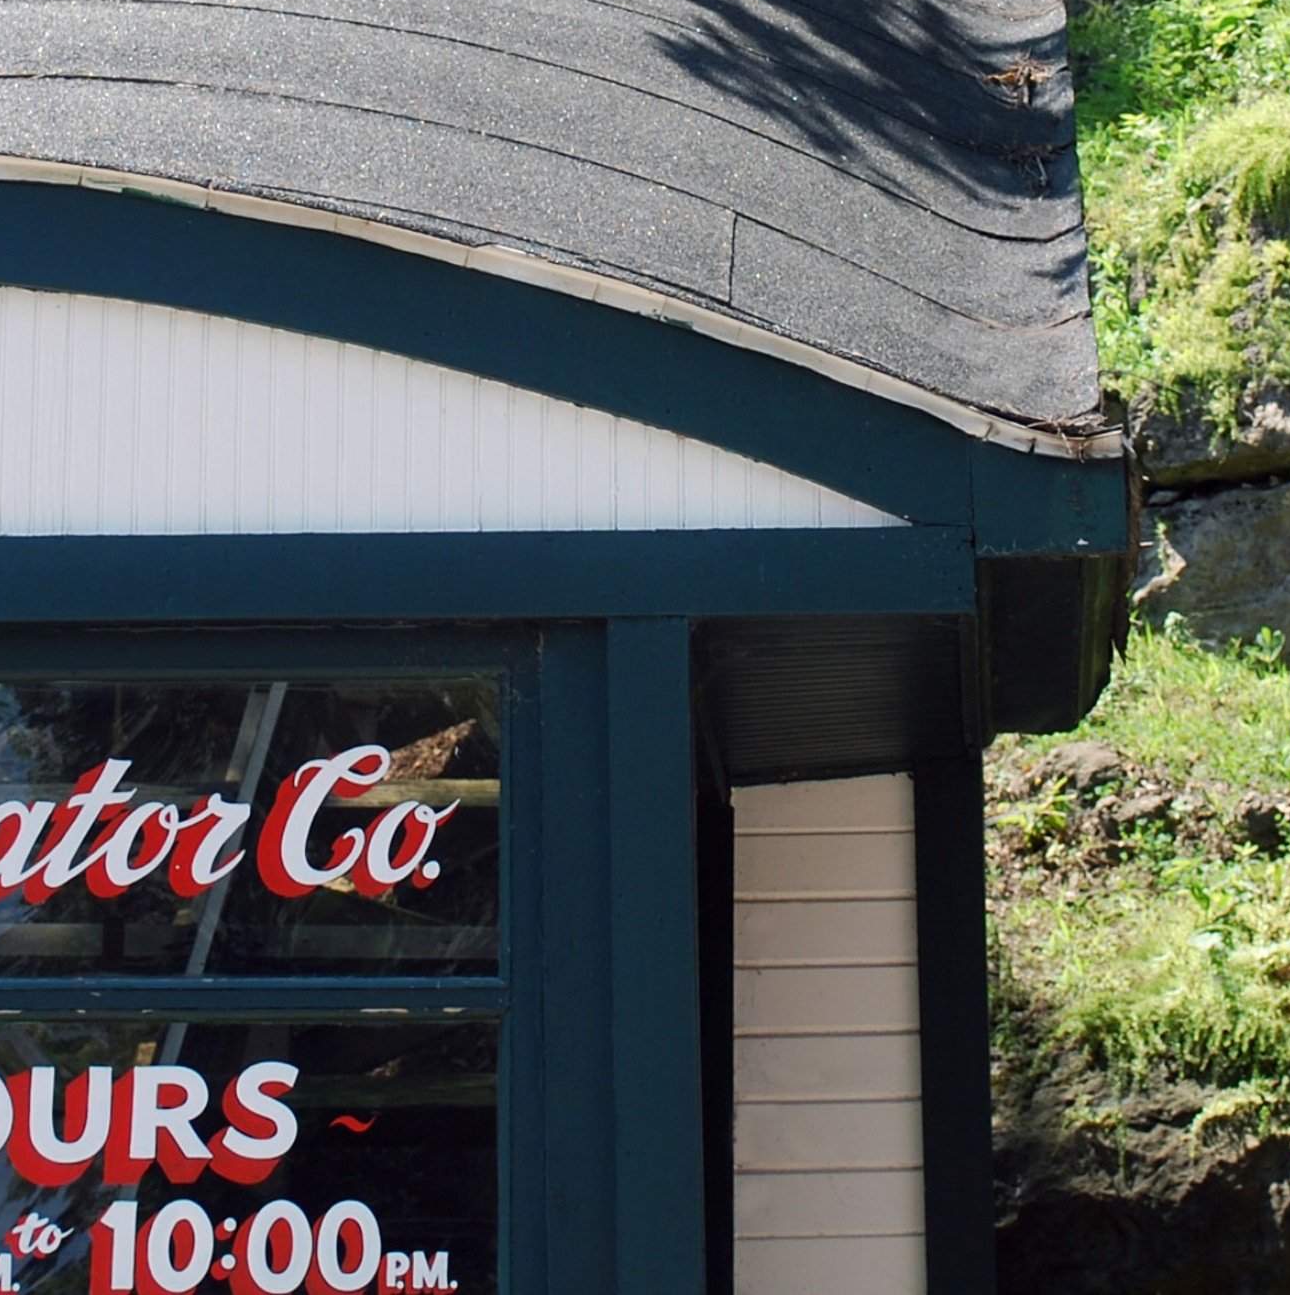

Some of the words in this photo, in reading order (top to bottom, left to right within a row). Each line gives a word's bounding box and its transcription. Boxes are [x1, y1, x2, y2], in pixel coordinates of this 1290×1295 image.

[278, 744, 460, 886] Co.
[13, 1212, 74, 1255] to
[99, 1198, 382, 1294] 10:00
